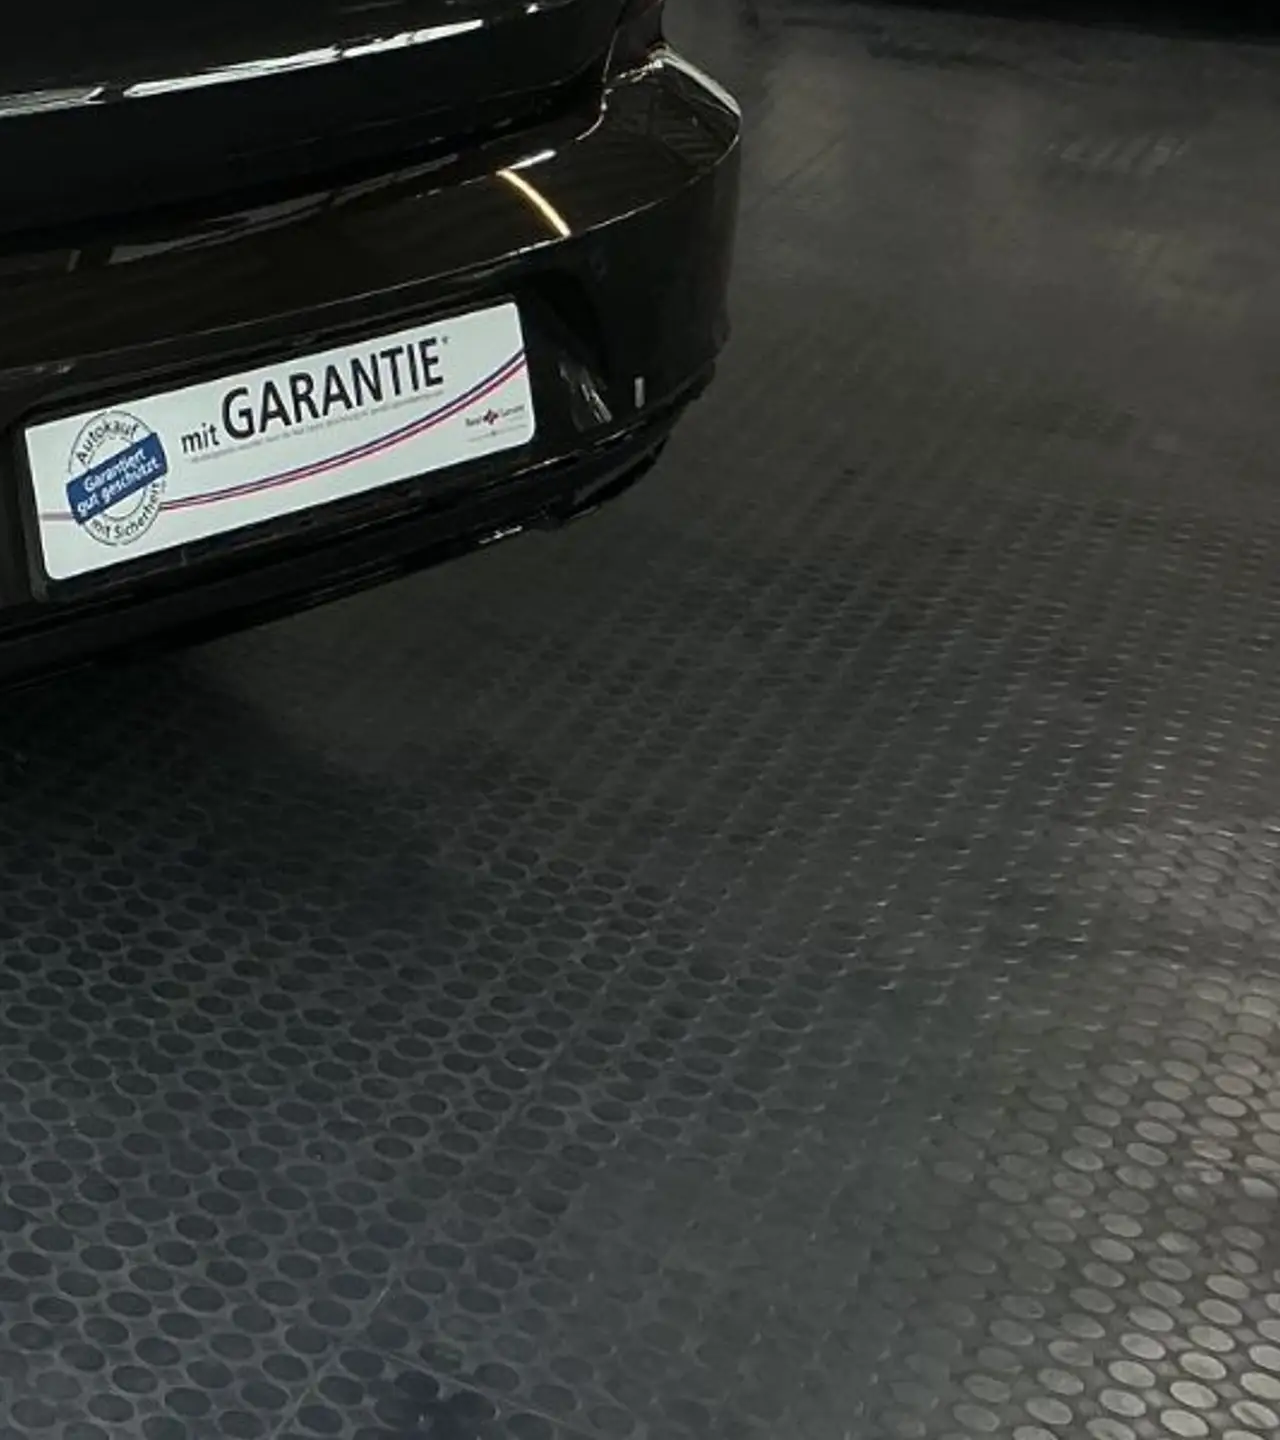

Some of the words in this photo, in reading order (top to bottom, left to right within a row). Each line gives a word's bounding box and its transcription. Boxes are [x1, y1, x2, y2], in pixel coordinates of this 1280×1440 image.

[180, 422, 220, 454] mit
[221, 336, 444, 441] GARANTIE
[76, 419, 139, 468] Autokauf
[84, 448, 147, 493] Garantiert
[77, 494, 101, 517] gut
